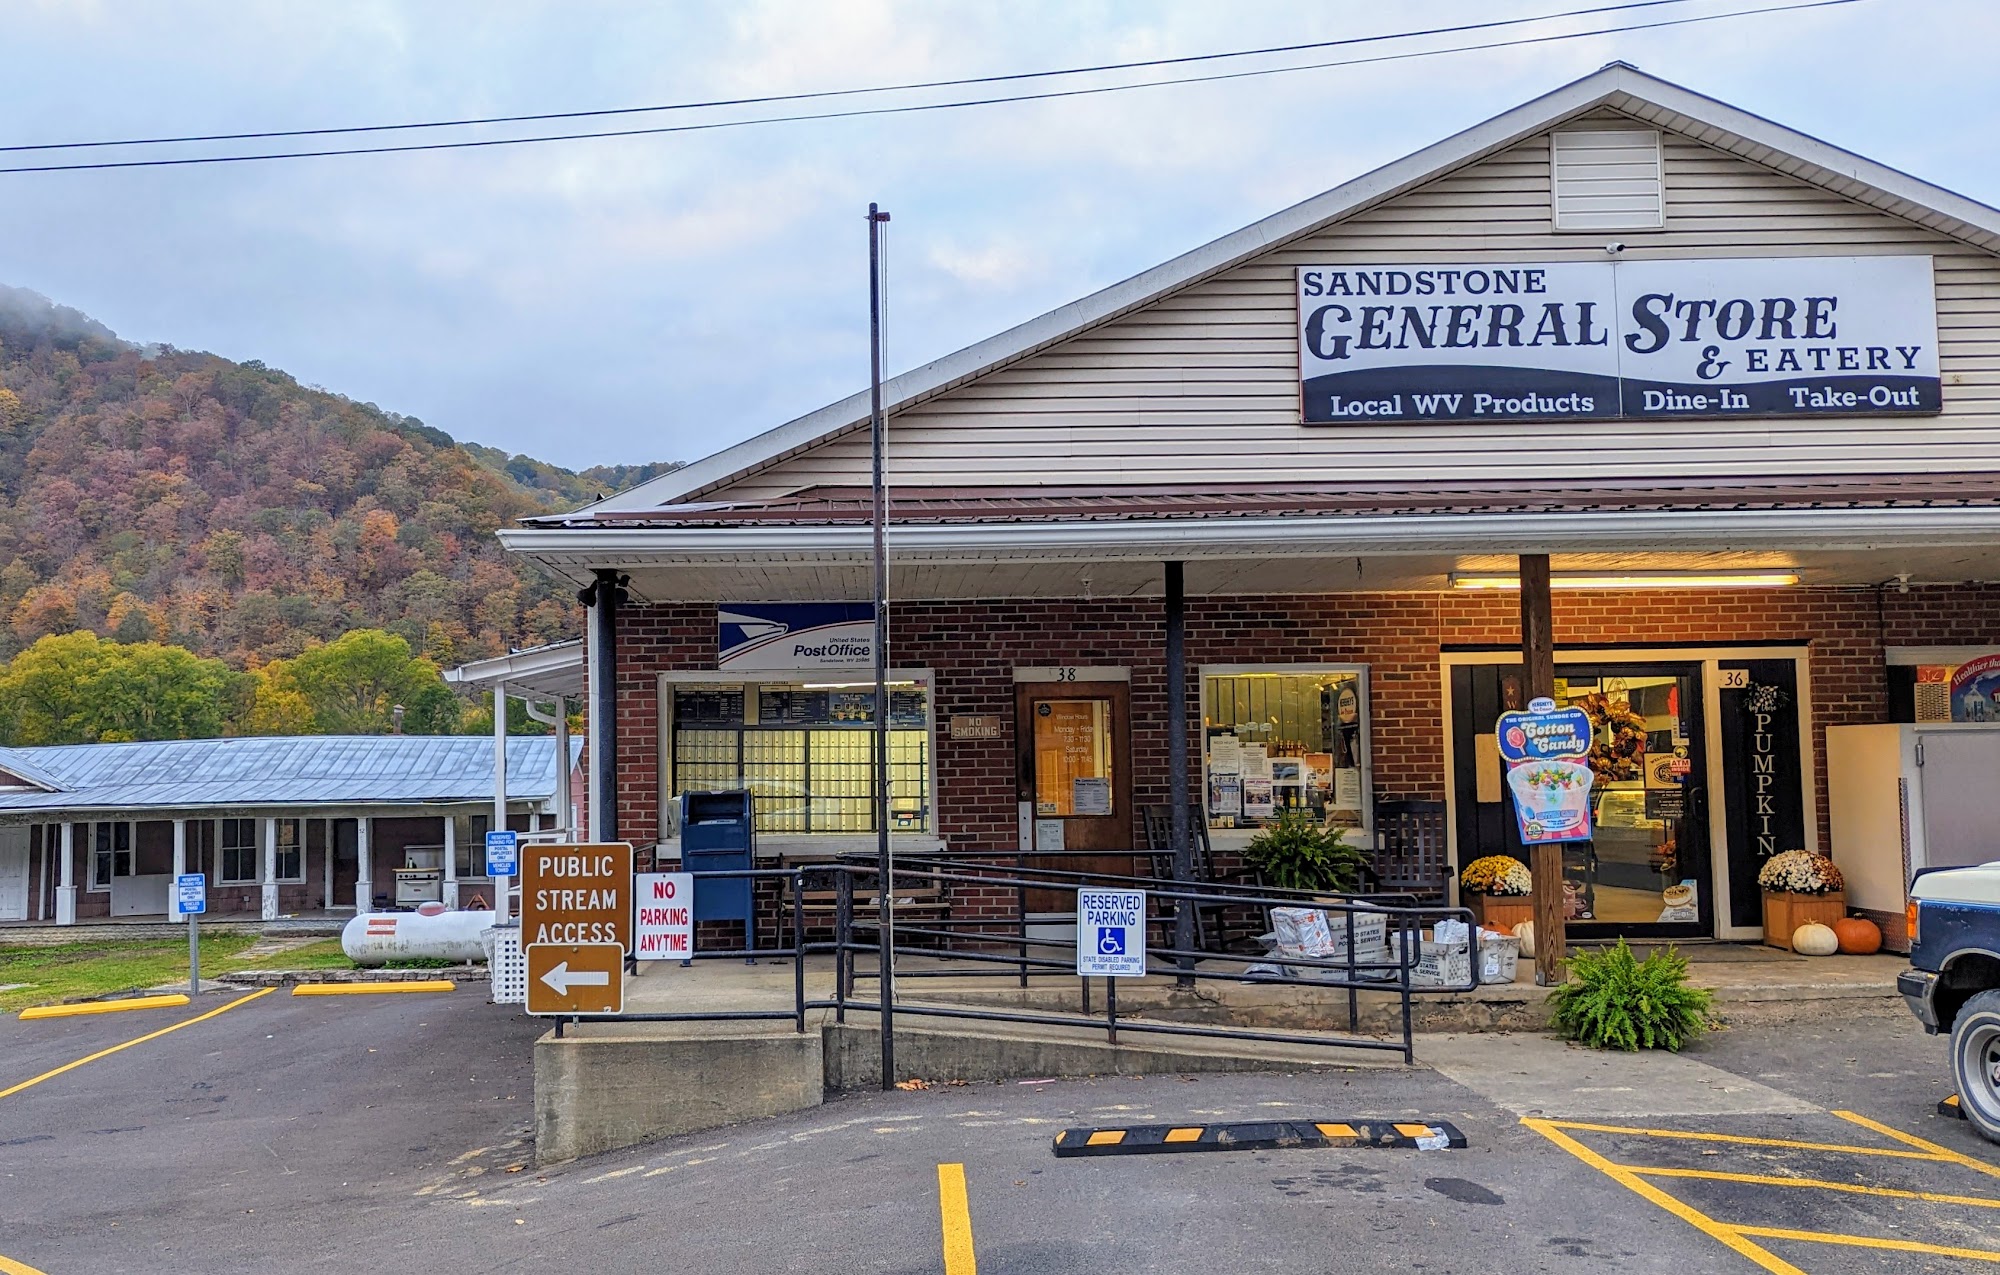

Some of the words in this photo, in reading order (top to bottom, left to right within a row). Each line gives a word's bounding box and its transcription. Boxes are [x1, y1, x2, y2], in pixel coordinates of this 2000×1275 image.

[1303, 269, 1546, 297] SANDSTONE
[1305, 302, 1608, 360] GENERAL
[1624, 292, 1838, 354] STORE
[1696, 345, 1733, 379] &
[1746, 346, 1921, 372] EATERY
[1331, 394, 1402, 416] Local
[1412, 394, 1463, 415] WV
[1474, 392, 1595, 414] Products
[1643, 389, 1750, 411] Dine-In
[1789, 385, 1920, 408] Take-Out
[1056, 668, 1076, 682] 38
[1724, 672, 1743, 686] 36
[1952, 661, 1988, 685] Healthier
[968, 718, 982, 726] NO
[1054, 726, 1076, 734] Monday
[1520, 722, 1576, 738] Cotton
[954, 726, 997, 738] SMOKING
[1066, 746, 1088, 755] Saturday
[1532, 734, 1585, 753] Candy
[1752, 714, 1776, 855] PUMPKIN
[539, 856, 614, 878] PUBLIC
[536, 889, 616, 910] STREAM
[653, 882, 676, 899] NO
[1083, 895, 1140, 910] RESERVED
[640, 908, 688, 926] PARKING
[1088, 911, 1136, 926] PARKING
[537, 922, 616, 943] ACCESS
[640, 934, 688, 951] ANYTIME
